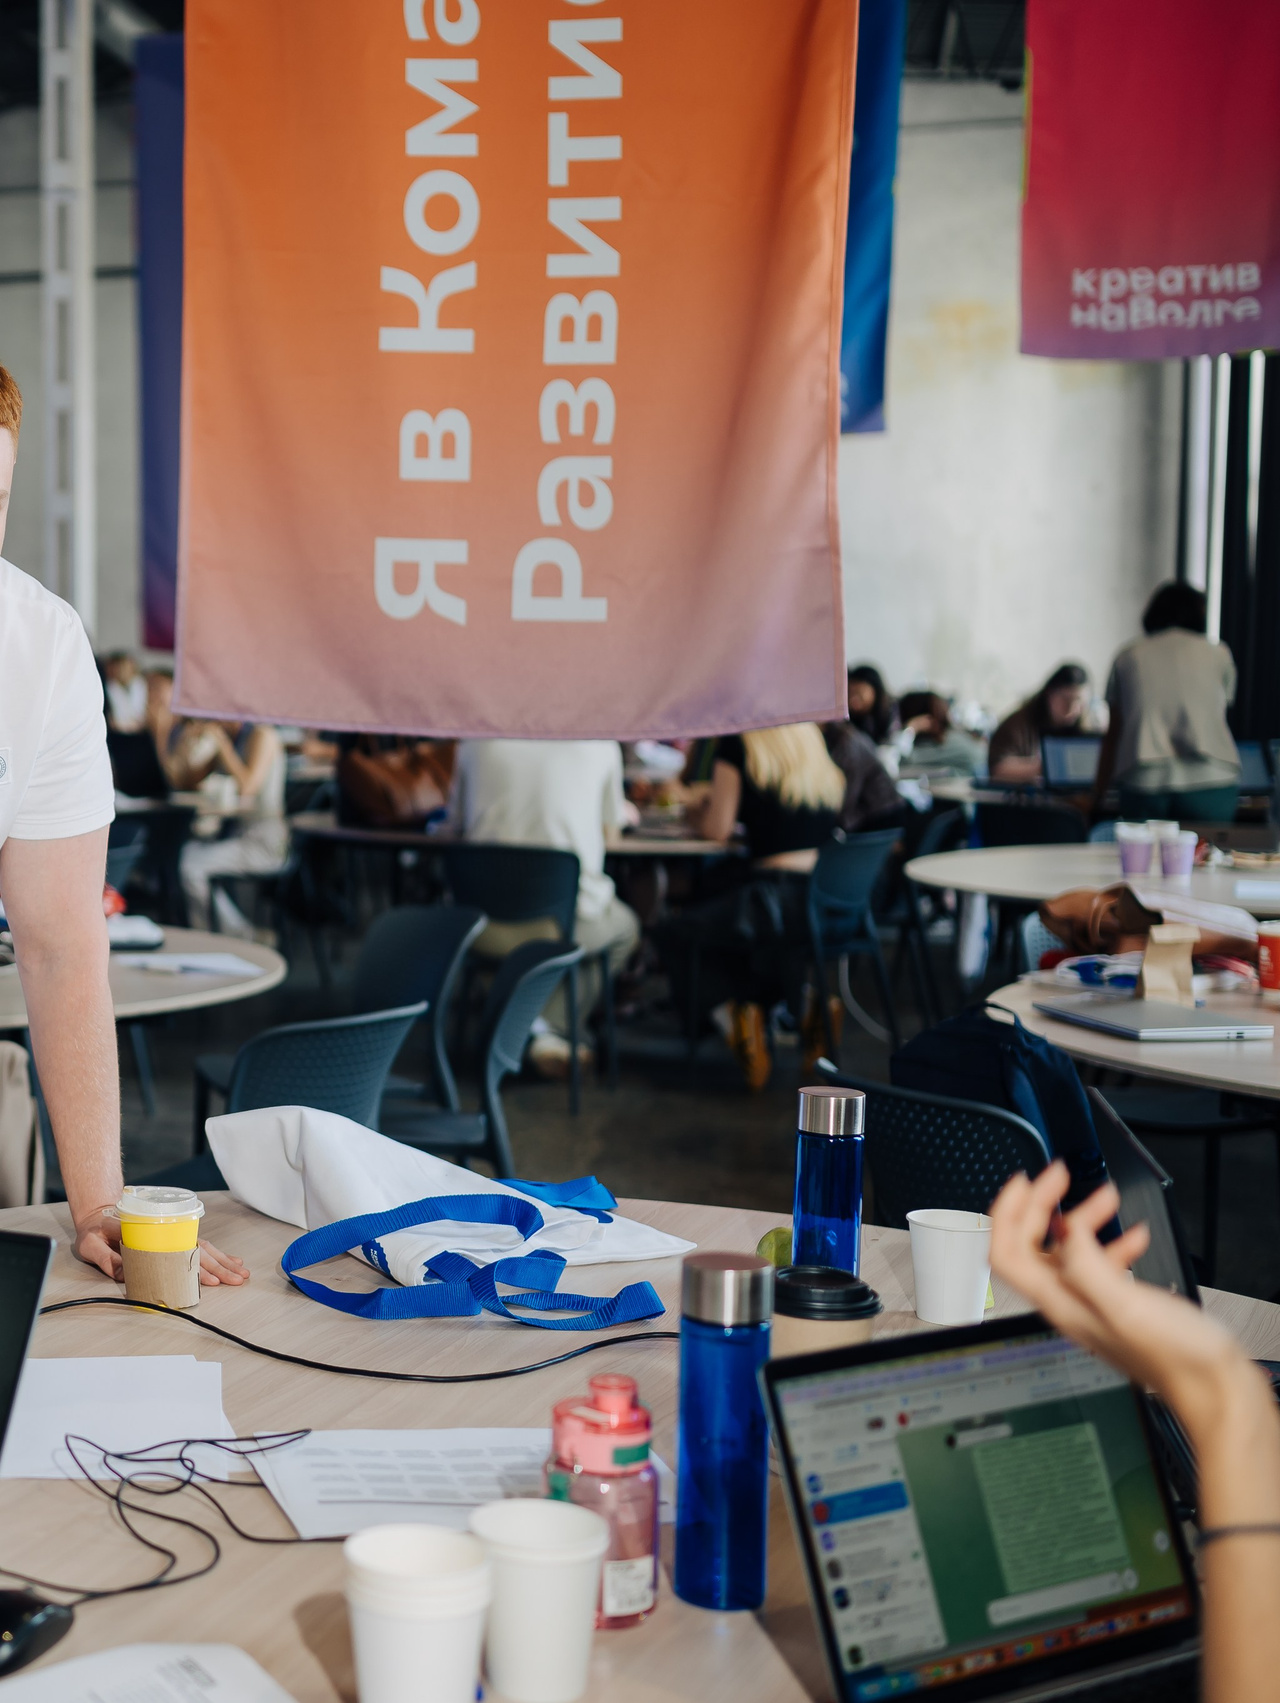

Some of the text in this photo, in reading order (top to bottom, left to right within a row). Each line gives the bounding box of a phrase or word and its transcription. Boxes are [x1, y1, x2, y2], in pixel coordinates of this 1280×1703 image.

[511, 0, 623, 623] Развити
[1071, 263, 1261, 302] креатив
[399, 407, 472, 482] в
[373, 536, 468, 627] Я
